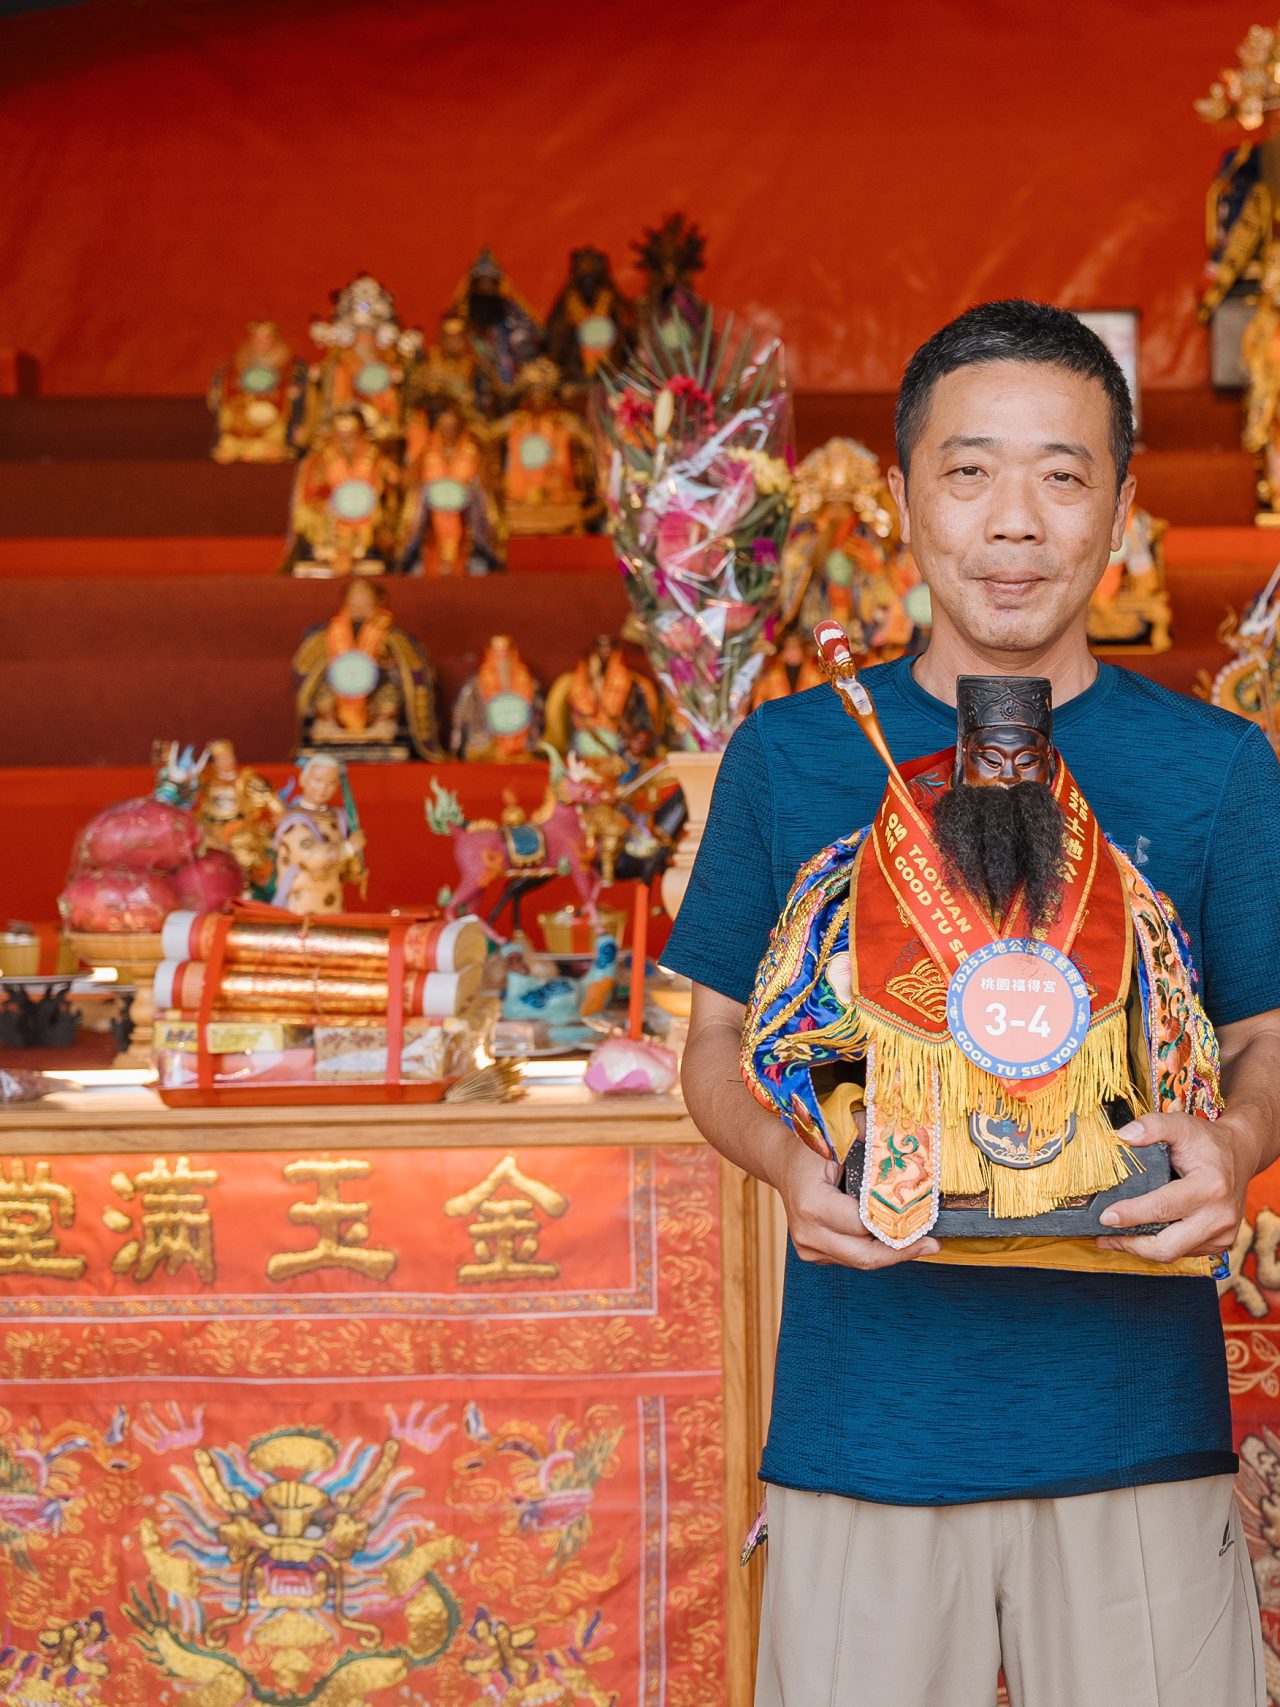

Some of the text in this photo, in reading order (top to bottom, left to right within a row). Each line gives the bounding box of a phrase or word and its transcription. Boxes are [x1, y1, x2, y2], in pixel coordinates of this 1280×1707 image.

[894, 856, 932, 906] GOOD
[930, 908, 953, 935] TU
[908, 844, 972, 933] TAOYUAN
[985, 1002, 1051, 1038] 3-4
[956, 1030, 1078, 1077] GOOD TU SEE YOU
